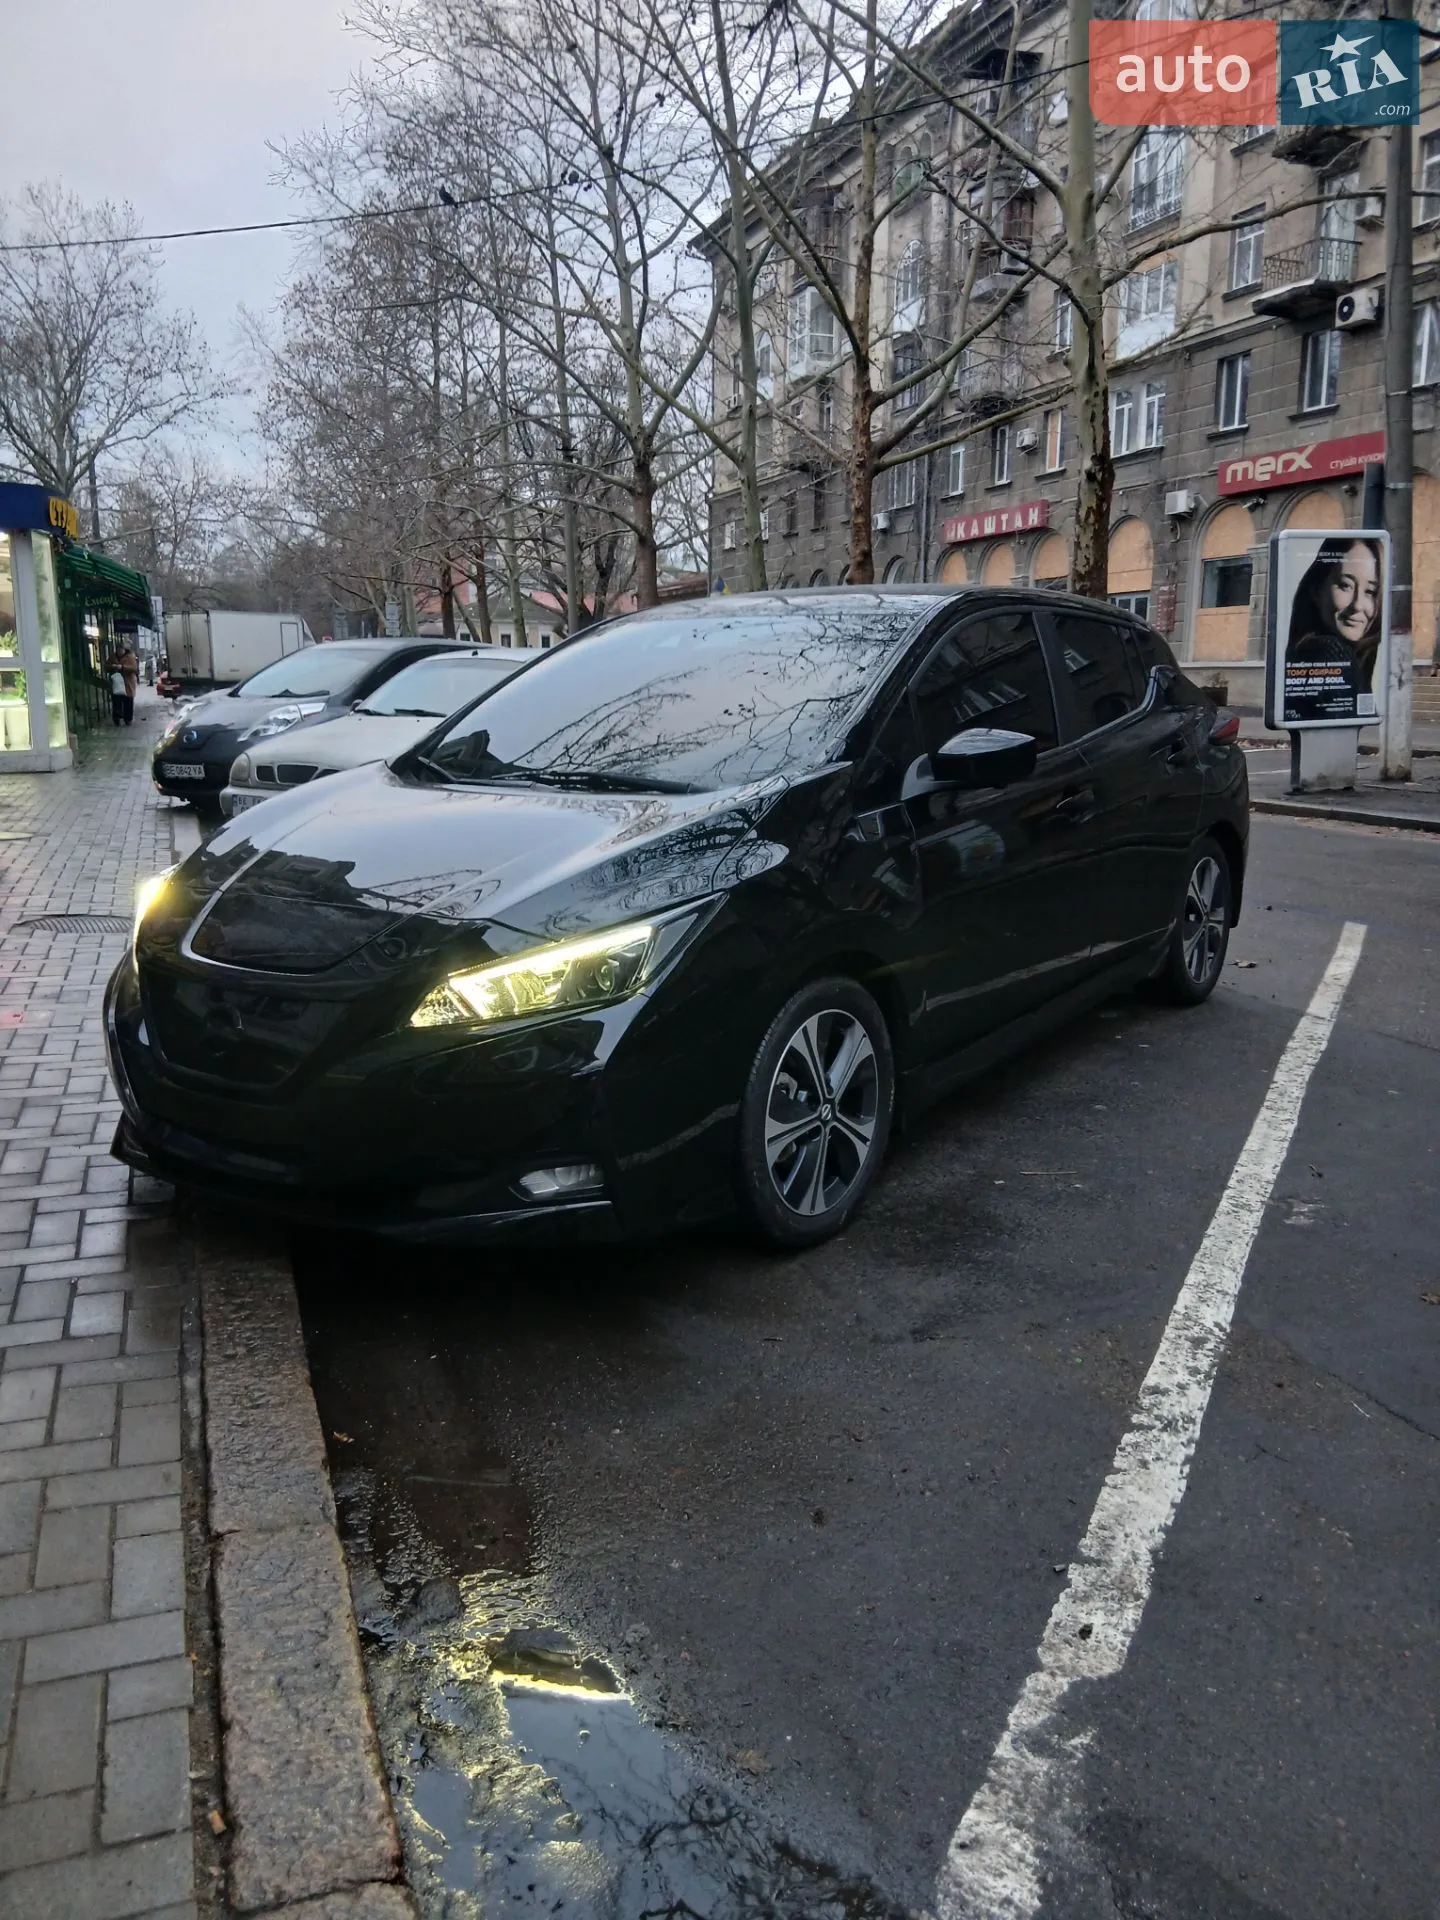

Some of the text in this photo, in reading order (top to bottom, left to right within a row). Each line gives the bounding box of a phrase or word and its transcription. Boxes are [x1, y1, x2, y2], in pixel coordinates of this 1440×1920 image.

[1226, 443, 1320, 484] merx
[1286, 677, 1306, 685] BODY
[1325, 676, 1345, 684] SOUL
